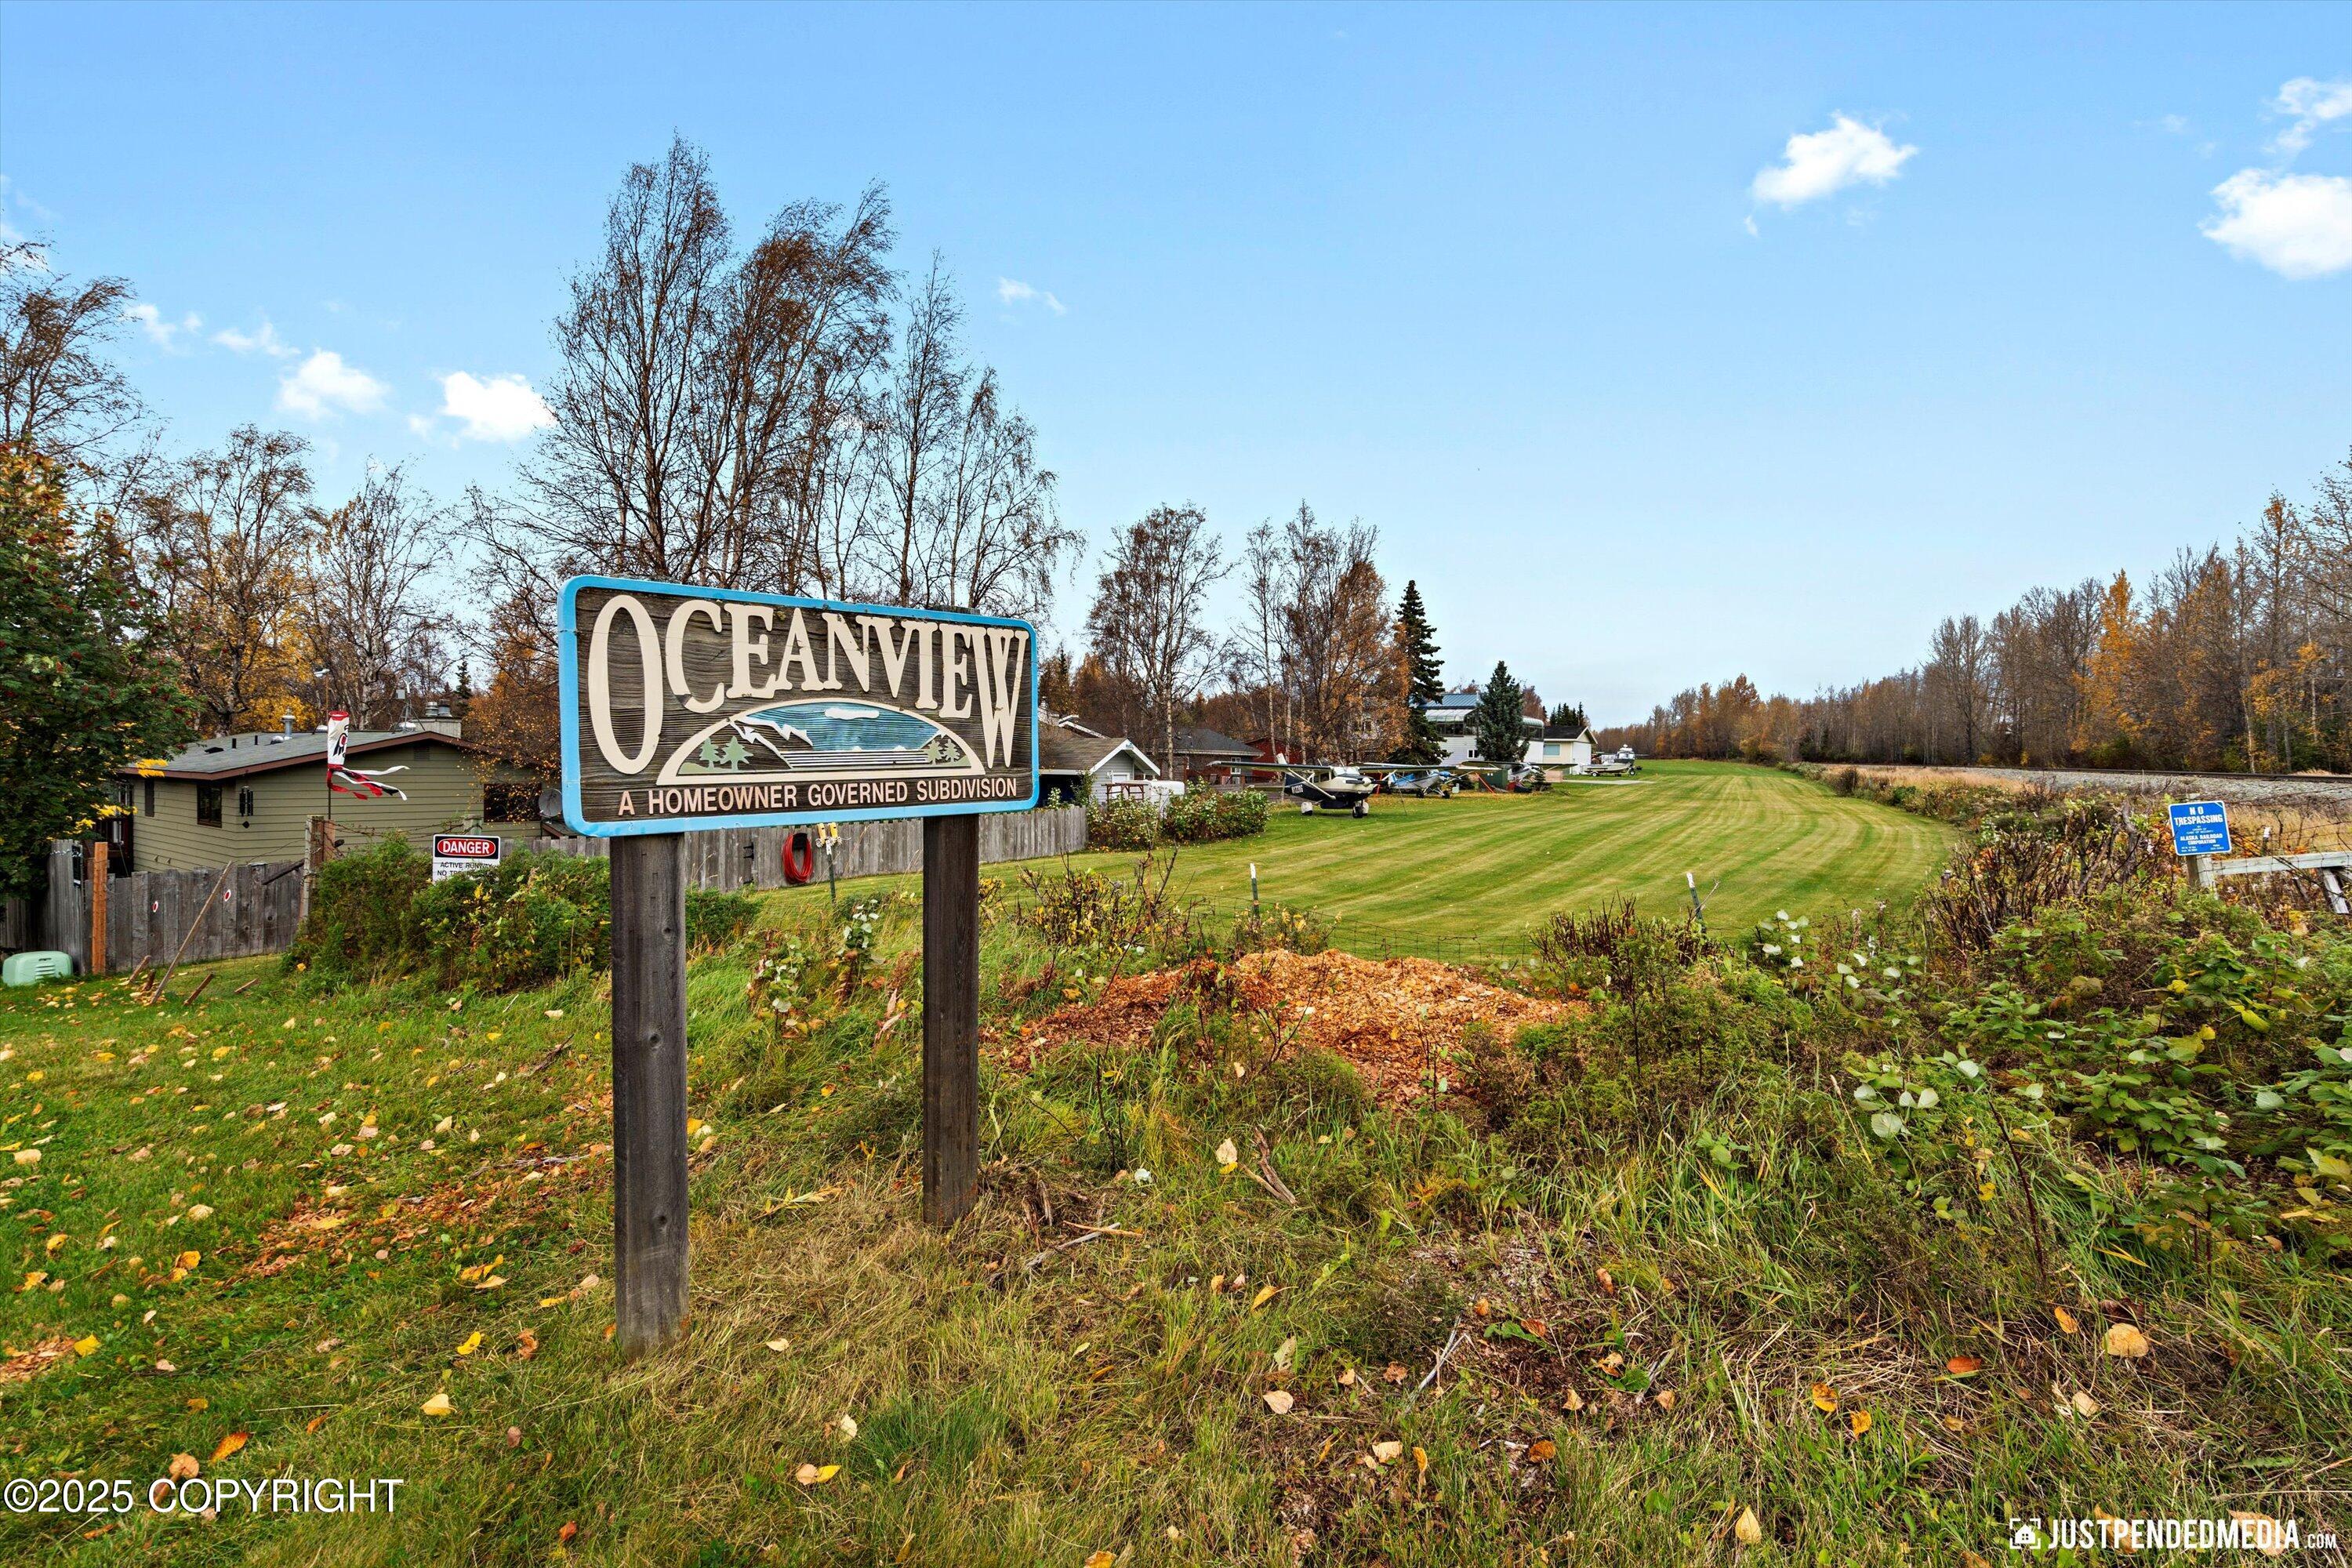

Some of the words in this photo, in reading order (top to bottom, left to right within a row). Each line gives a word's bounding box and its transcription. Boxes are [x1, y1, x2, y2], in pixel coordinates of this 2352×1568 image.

[589, 594, 1029, 775] OCEANVIEW
[618, 790, 635, 816] A
[648, 784, 798, 815] HOMEOWNER
[808, 782, 909, 807] GOVERNED
[916, 778, 1018, 800] SUBDIVISION
[2174, 815, 2223, 826] TRESPASSING
[442, 840, 490, 855] DANGER
